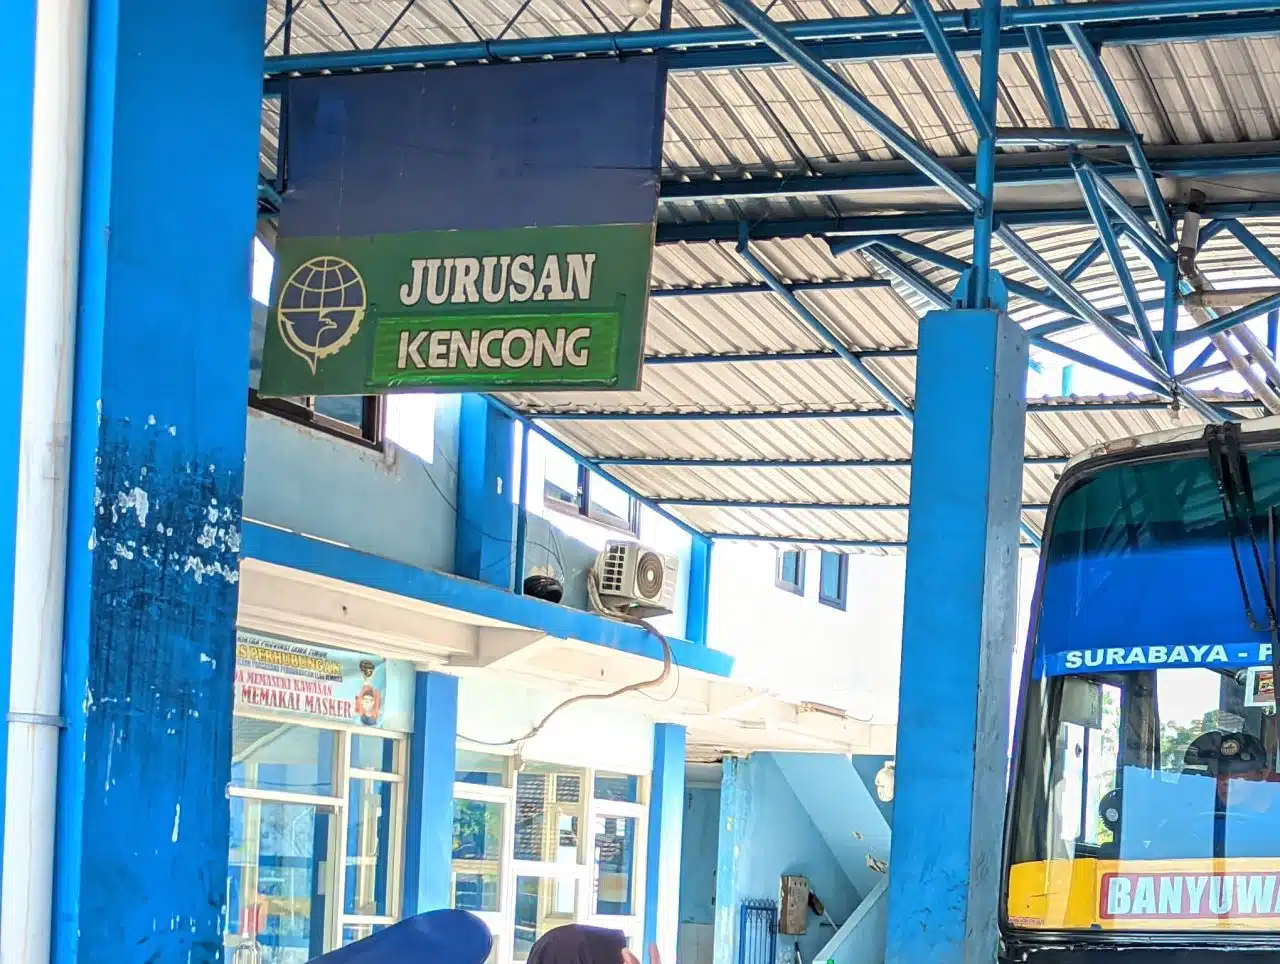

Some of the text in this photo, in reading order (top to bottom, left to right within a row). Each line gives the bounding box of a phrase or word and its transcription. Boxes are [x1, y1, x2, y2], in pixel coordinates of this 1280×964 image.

[399, 252, 597, 306] JURUSAN
[397, 327, 591, 369] KENCONG
[250, 645, 342, 676] PERHUBUNGAN
[1064, 645, 1229, 669] SURABAYA
[246, 671, 291, 690] MEMASUKI
[293, 680, 333, 695] KAWASAN
[241, 685, 352, 718] MEMAKAI MASKER
